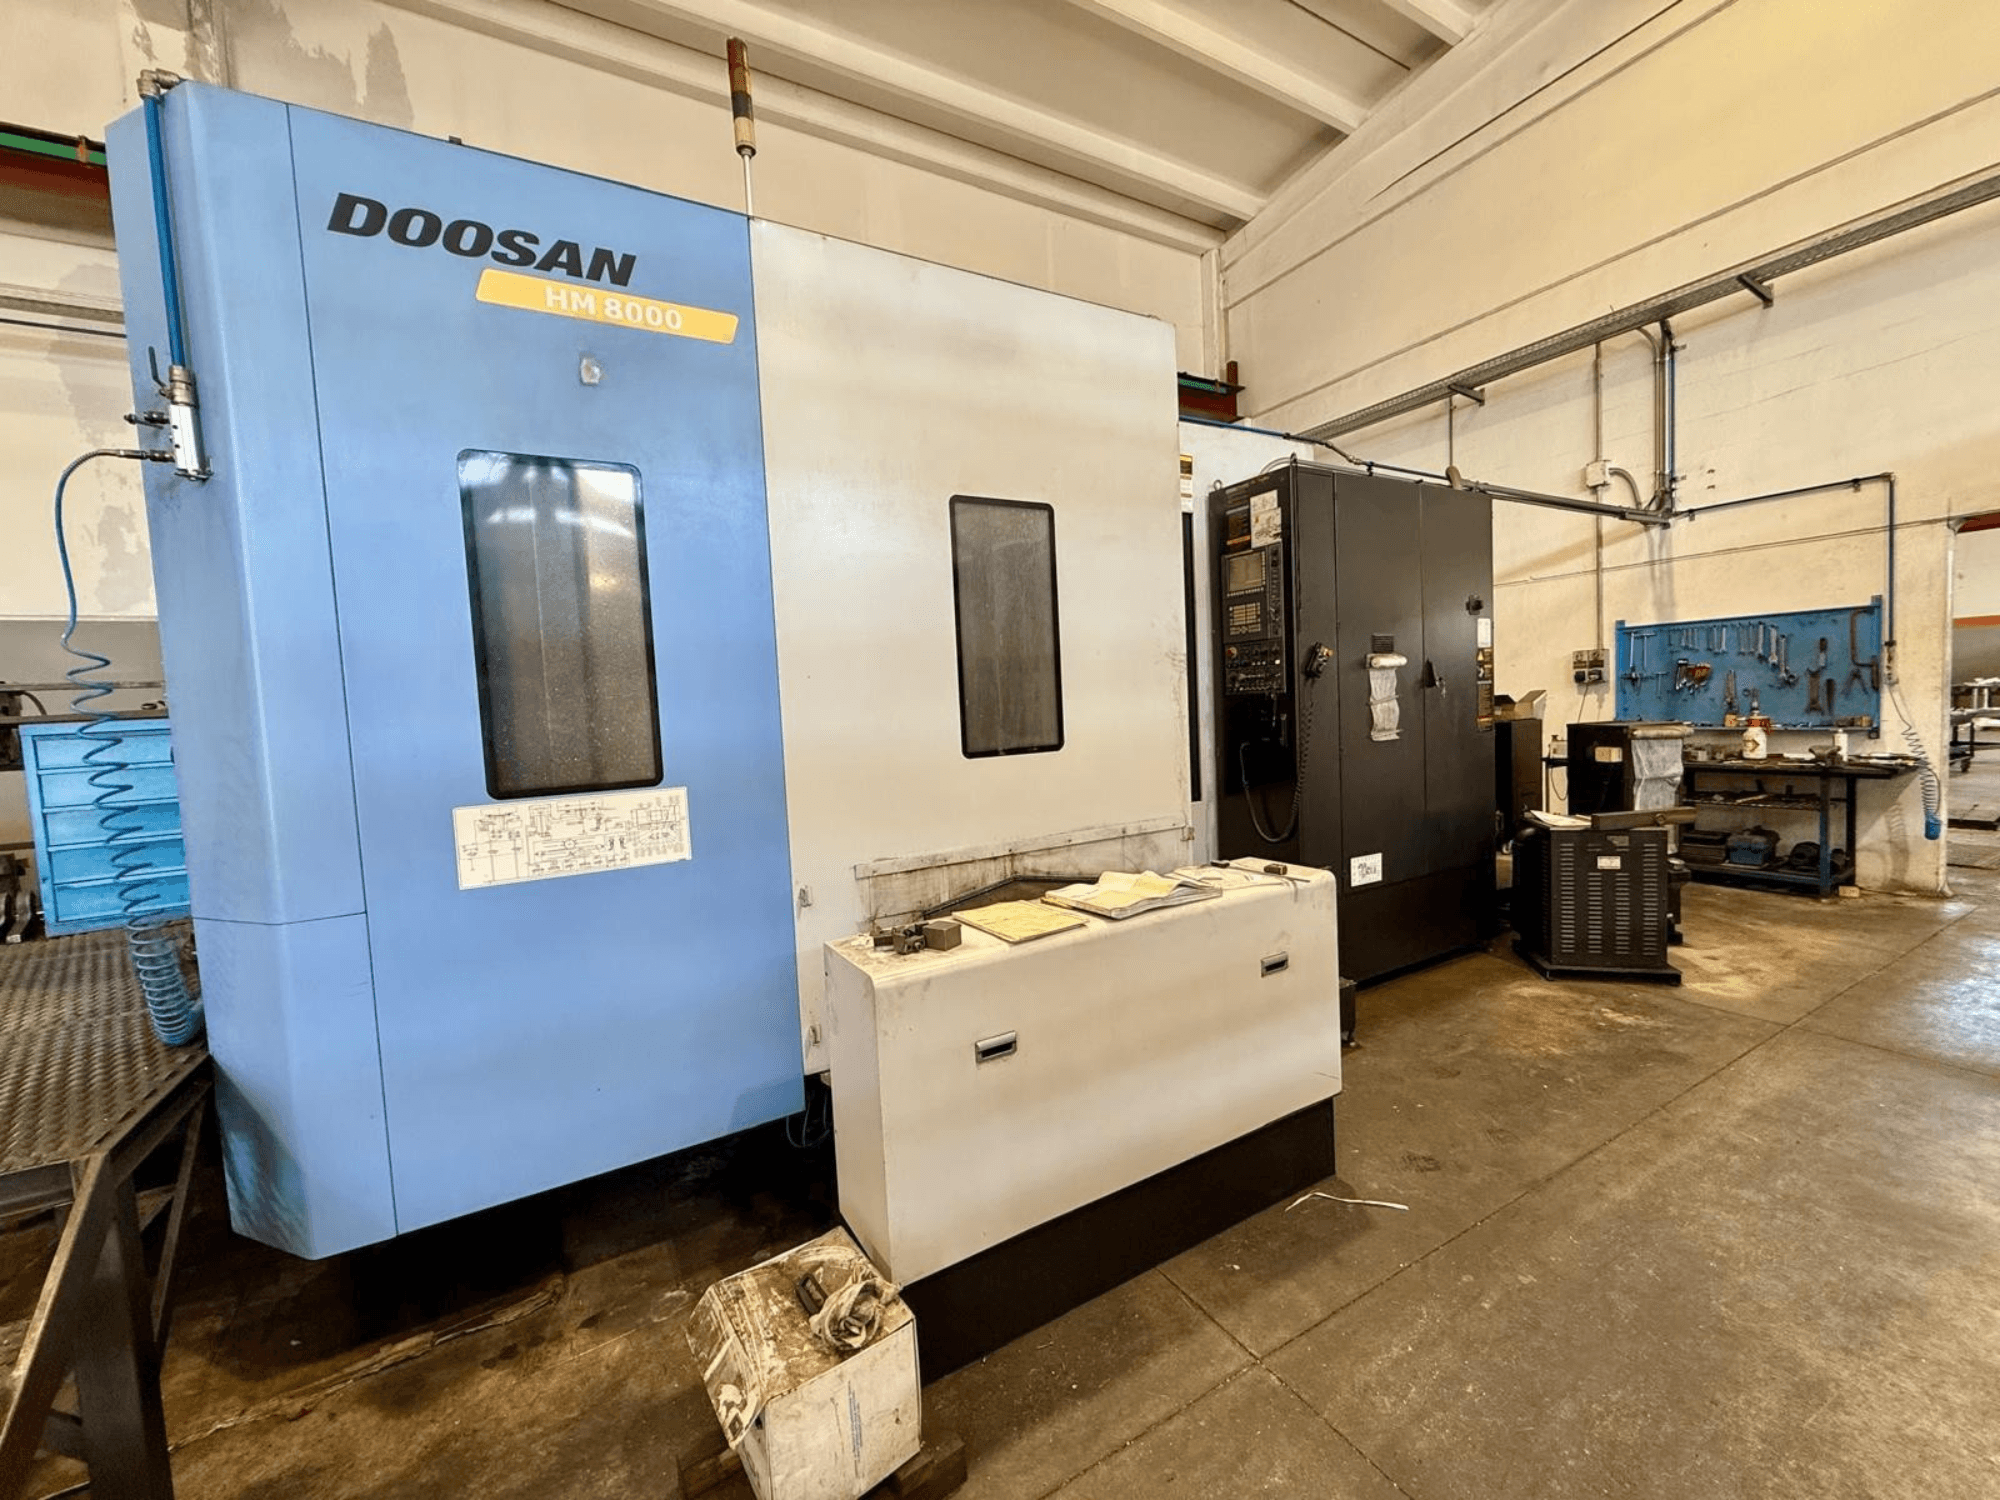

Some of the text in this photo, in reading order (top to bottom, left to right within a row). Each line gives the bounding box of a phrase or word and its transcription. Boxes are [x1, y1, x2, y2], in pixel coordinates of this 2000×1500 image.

[327, 192, 637, 287] DOOSAN
[545, 286, 683, 330] HM 8000
